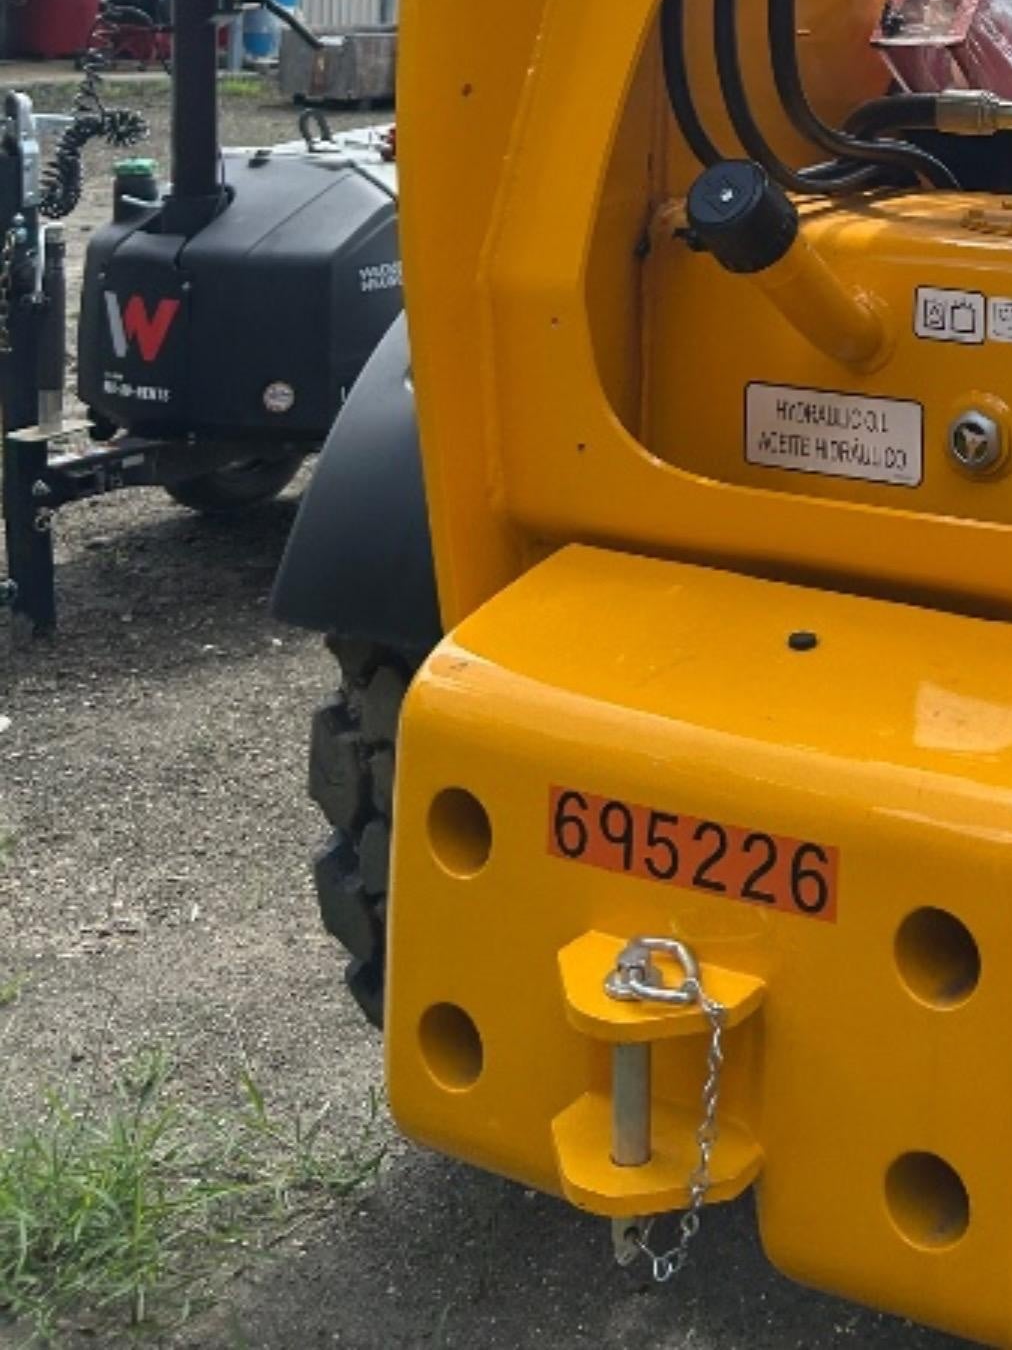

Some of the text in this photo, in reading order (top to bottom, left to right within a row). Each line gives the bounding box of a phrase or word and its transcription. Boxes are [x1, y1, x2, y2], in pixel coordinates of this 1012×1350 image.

[776, 398, 862, 430] HYDRAULIC
[758, 430, 811, 457] ACEITE
[554, 790, 829, 914] 695226
